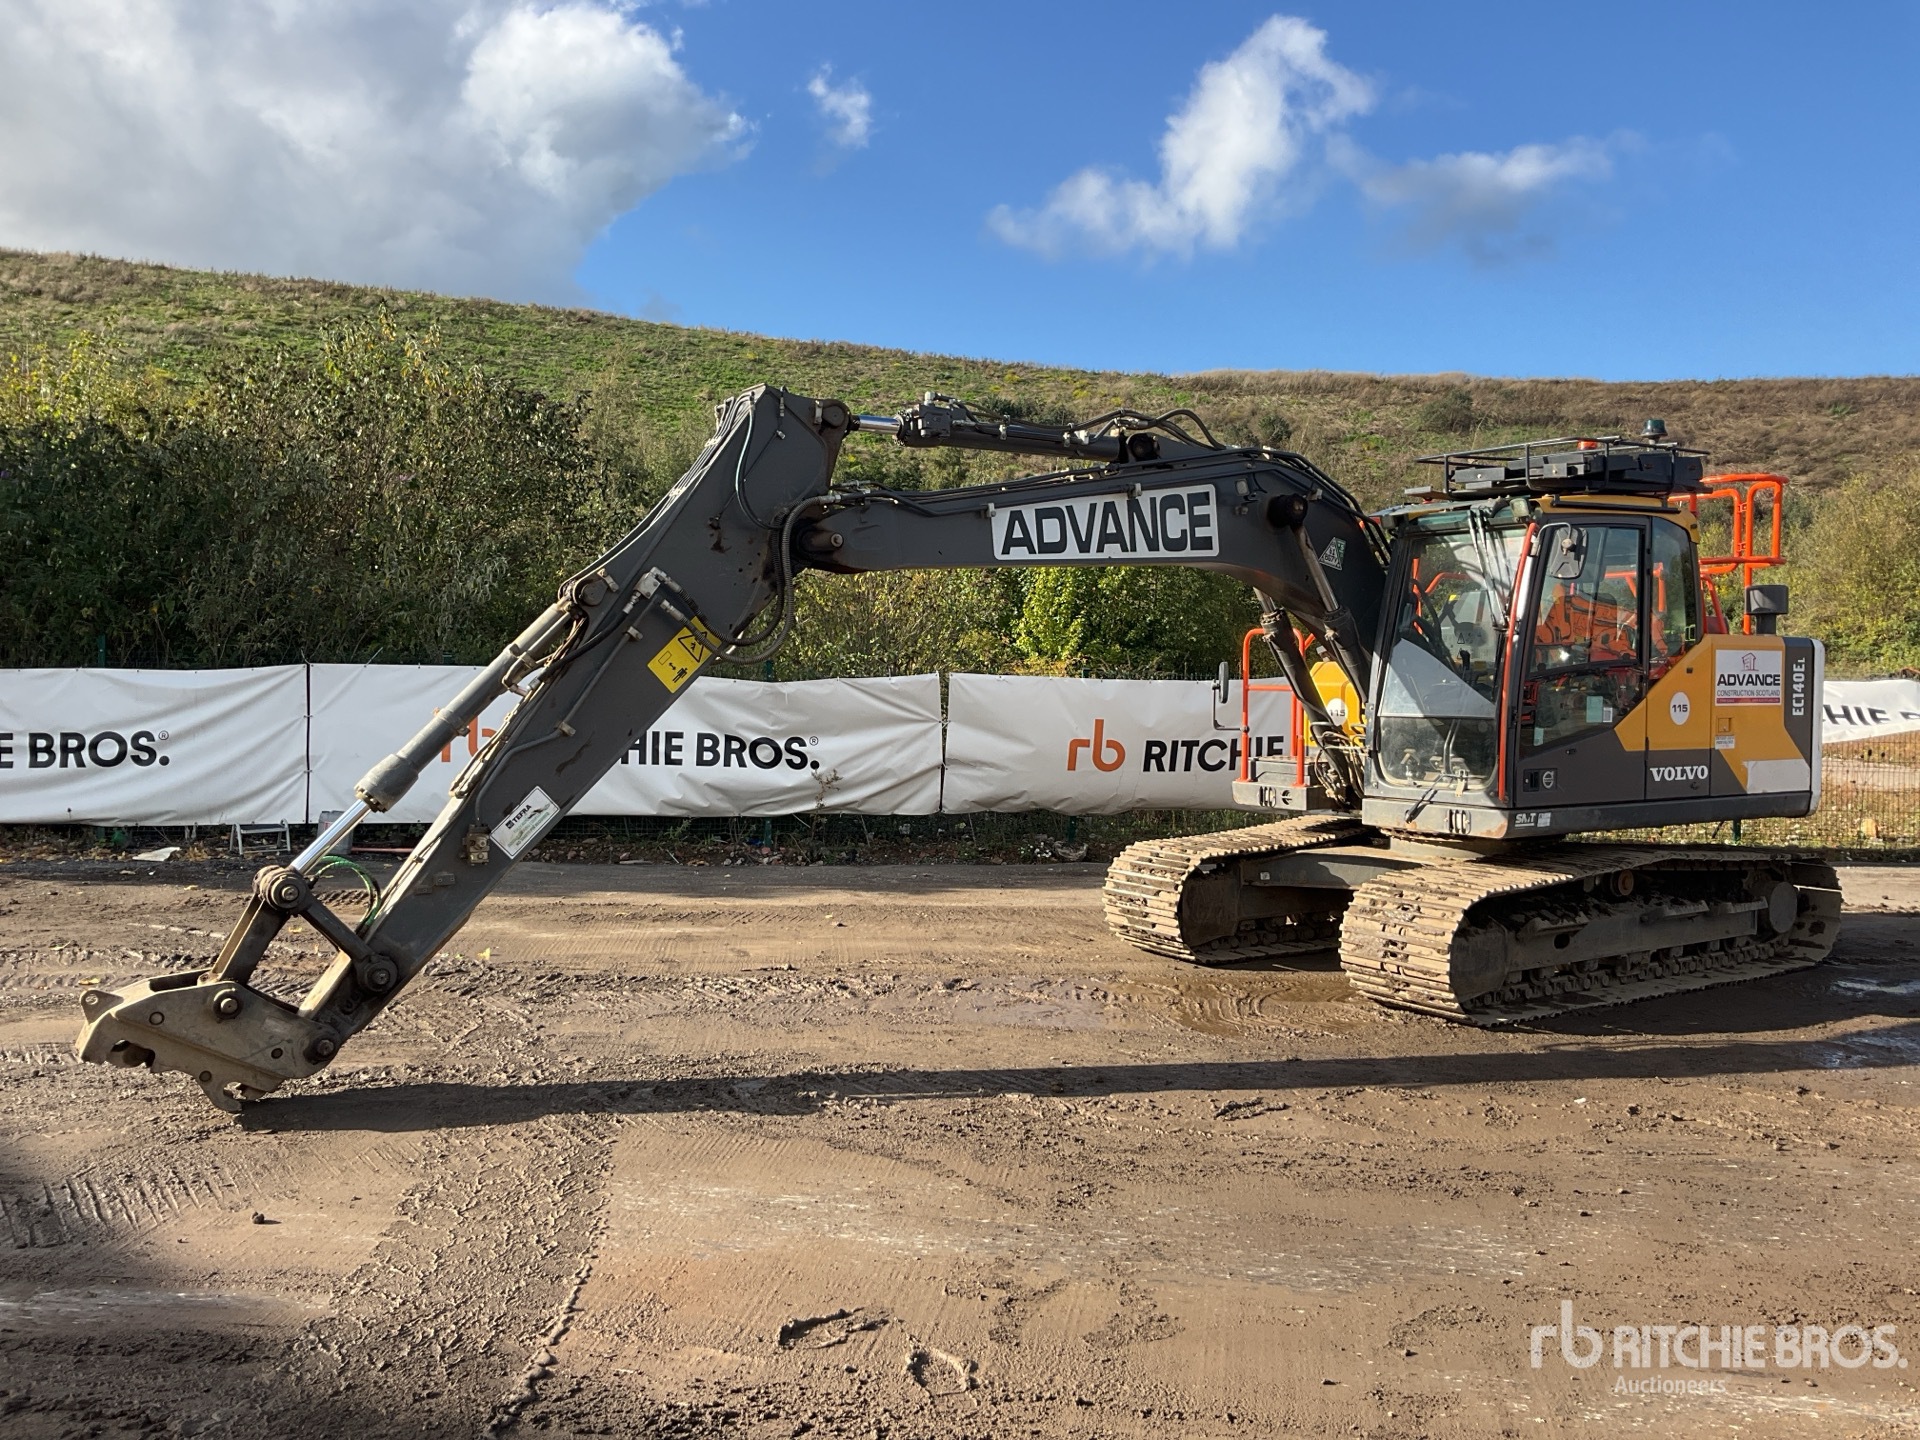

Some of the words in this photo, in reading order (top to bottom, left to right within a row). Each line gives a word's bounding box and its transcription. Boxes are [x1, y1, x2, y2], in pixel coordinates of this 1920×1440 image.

[1001, 491, 1213, 555] ADVANCE
[1717, 674, 1780, 686] ADVANCE
[1717, 689, 1754, 697] CONSTRUCTION
[1756, 689, 1780, 697] SCOTLAND
[1330, 709, 1346, 717] 115
[1672, 704, 1688, 713] 115
[1650, 765, 1709, 782] VOLVO
[512, 804, 532, 823] TEFRA
